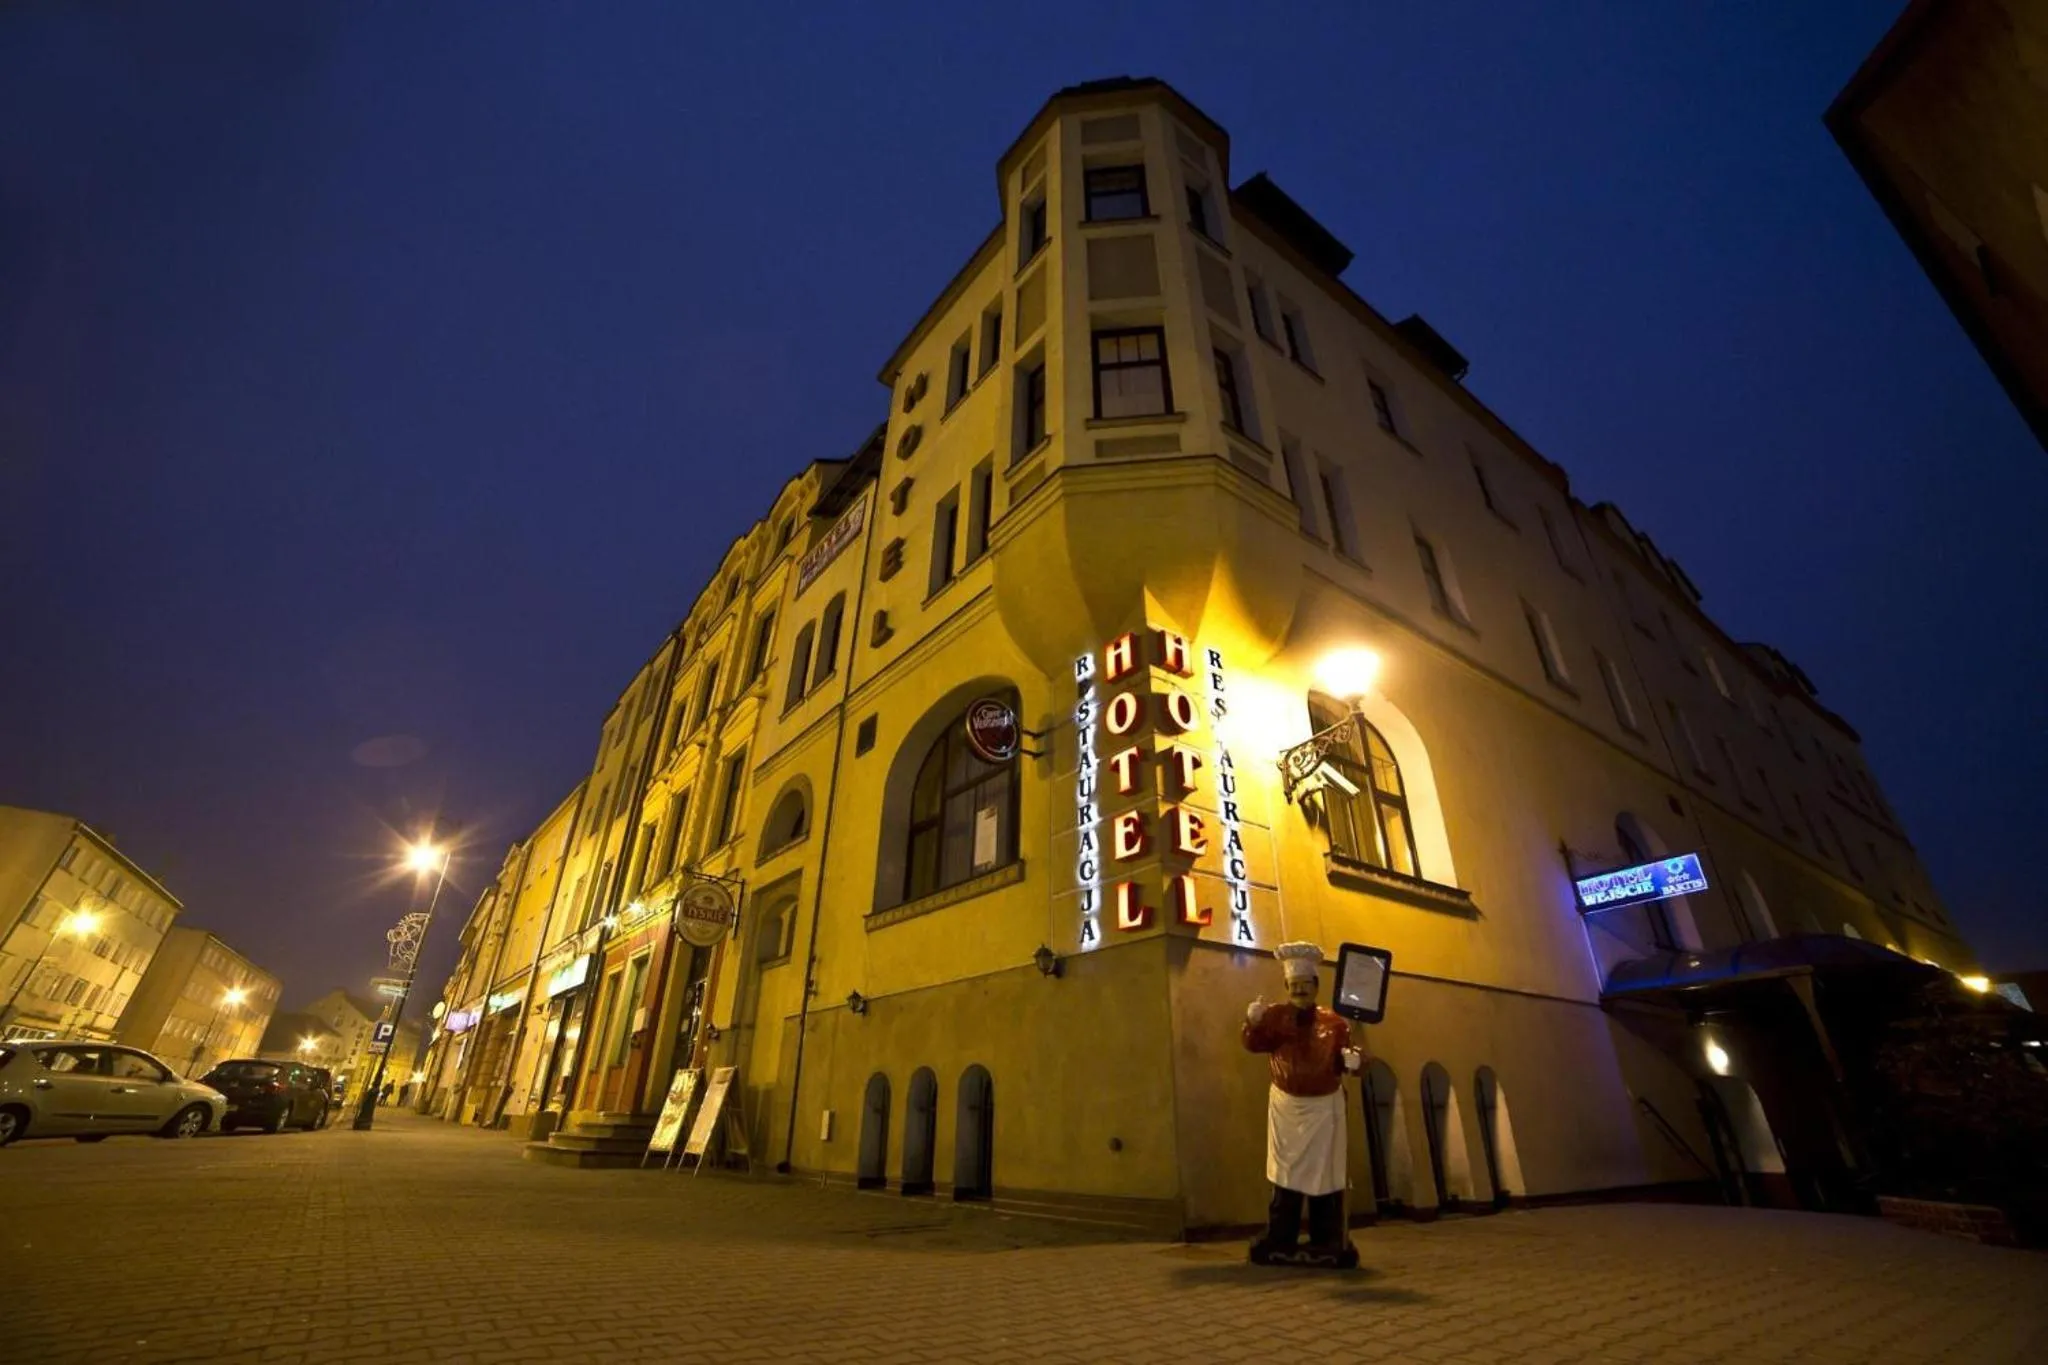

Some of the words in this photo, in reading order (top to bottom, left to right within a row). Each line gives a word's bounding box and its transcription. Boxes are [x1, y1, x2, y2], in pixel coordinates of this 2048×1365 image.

[1075, 655, 1096, 943] RSTAURACJA
[1105, 631, 1147, 932] HOTEL
[1162, 630, 1212, 932] HOTEL
[1208, 649, 1254, 942] RESAURACJA
[377, 1024, 393, 1040] P
